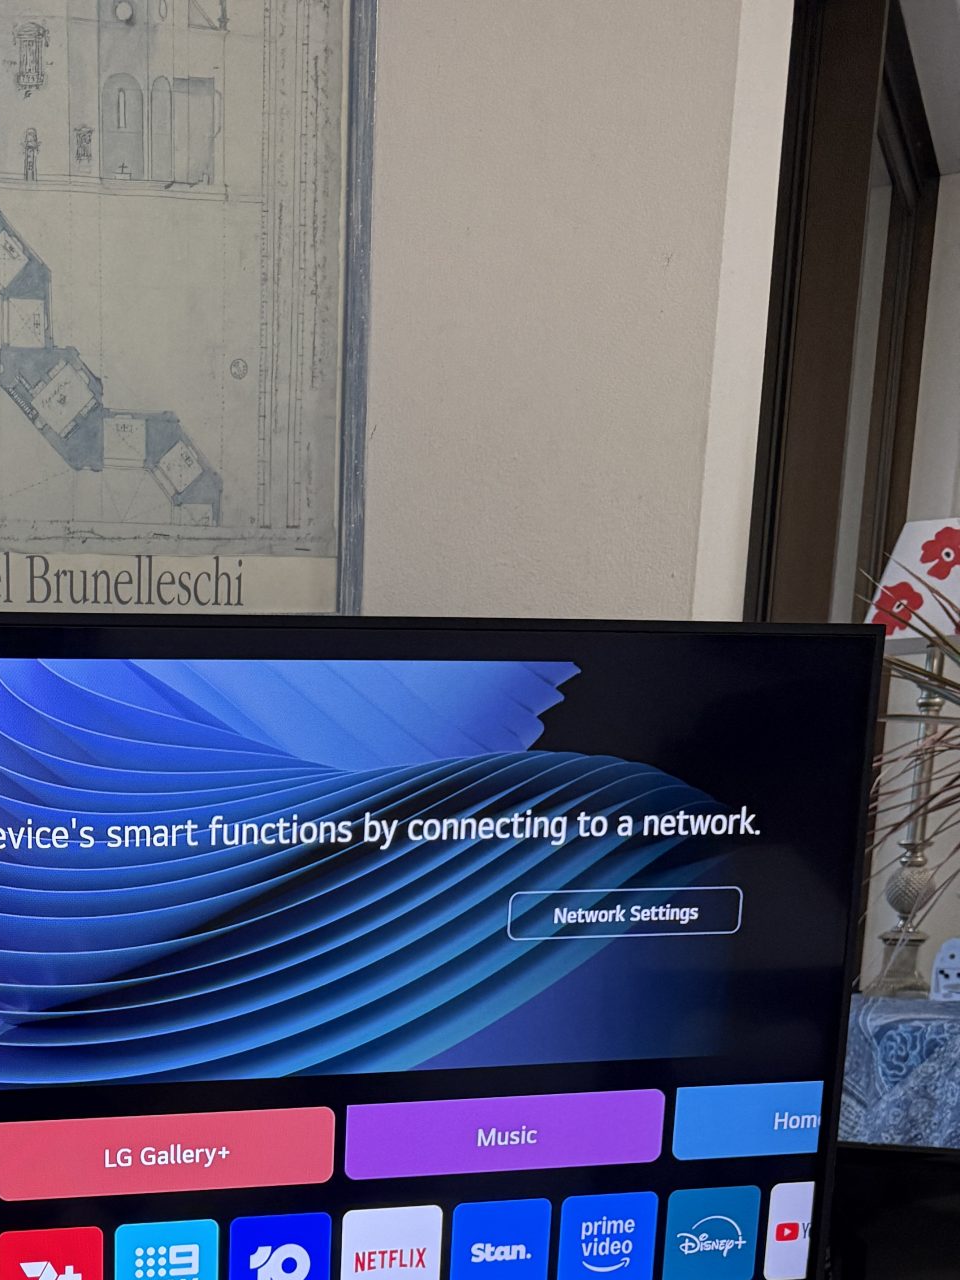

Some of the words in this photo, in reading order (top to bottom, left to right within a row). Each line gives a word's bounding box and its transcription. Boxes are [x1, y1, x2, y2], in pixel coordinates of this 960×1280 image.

[25, 554, 245, 607] Brunelleschi
[106, 817, 198, 849] smart
[208, 814, 353, 847] functions
[363, 812, 398, 850] by
[407, 808, 568, 846] connecting
[577, 810, 608, 838] to
[616, 813, 634, 837] a
[642, 805, 762, 837] network.
[552, 904, 626, 925] Network
[629, 903, 700, 925] Settings
[476, 1125, 538, 1149] Music
[103, 1147, 134, 1169] LG
[139, 1144, 231, 1170] Gallery+
[580, 1215, 636, 1239] prime
[470, 1241, 533, 1263] Stan.
[582, 1237, 634, 1257] video
[168, 1243, 201, 1277] 9
[354, 1247, 427, 1273] NETFLIX
